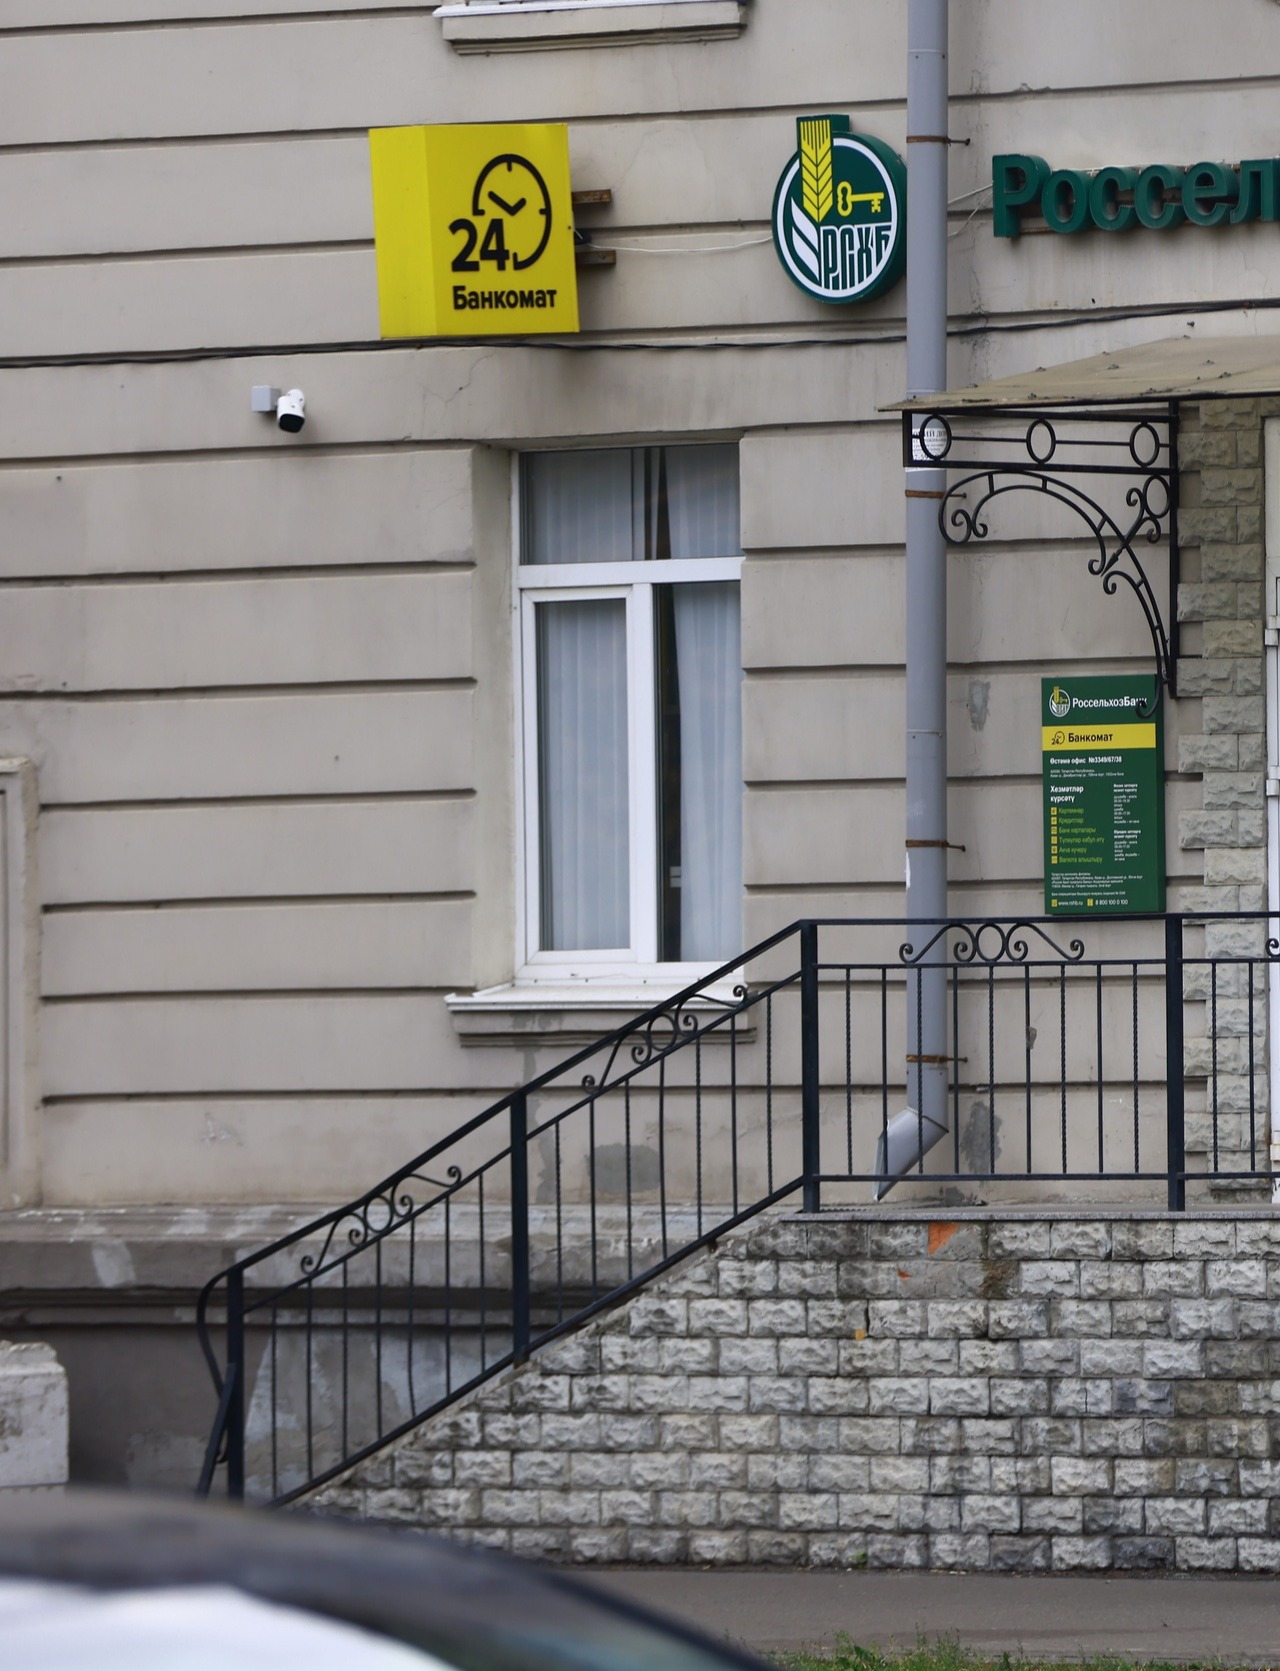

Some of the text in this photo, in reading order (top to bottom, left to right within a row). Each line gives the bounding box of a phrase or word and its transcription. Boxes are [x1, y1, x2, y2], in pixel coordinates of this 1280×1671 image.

[449, 219, 510, 272] 24
[453, 285, 557, 310] Банкомат
[1068, 732, 1113, 743] Банкомат
[1071, 757, 1086, 765] офис
